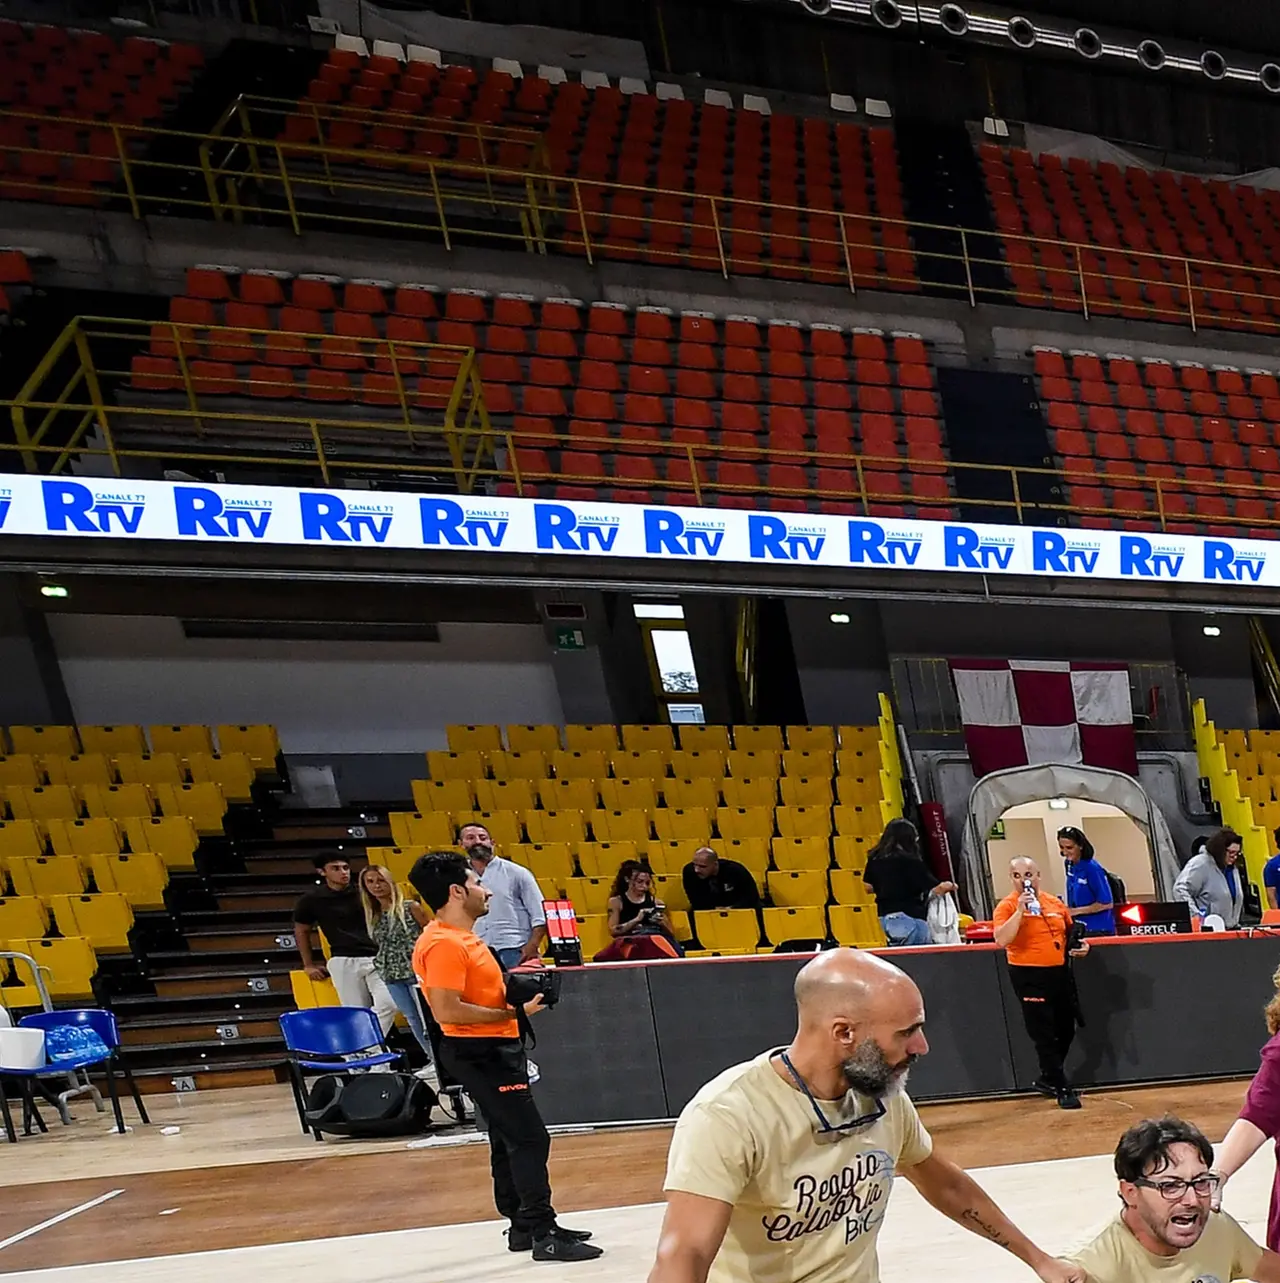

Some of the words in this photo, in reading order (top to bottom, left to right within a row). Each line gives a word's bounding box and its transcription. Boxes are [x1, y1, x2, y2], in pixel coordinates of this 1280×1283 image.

[95, 492, 132, 501] CANALE
[134, 494, 148, 502] 77
[225, 499, 261, 507] CANALE
[347, 504, 381, 512] CANALE
[383, 505, 395, 513] 77
[465, 509, 497, 517] CANALE
[578, 515, 609, 523] CANALE
[611, 516, 622, 524] 77
[793, 1153, 881, 1219] Reggio
